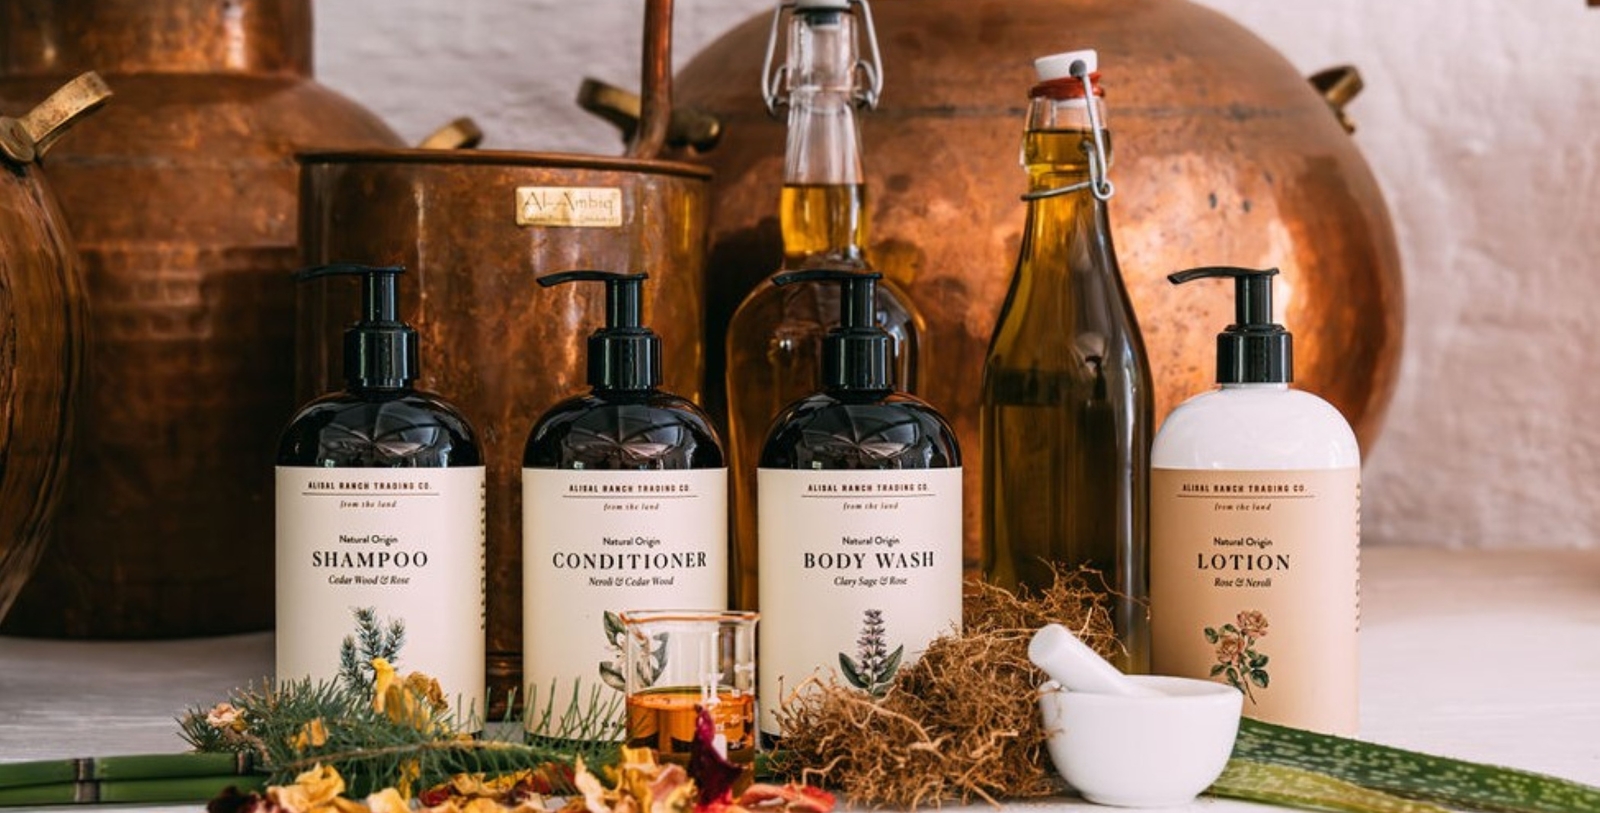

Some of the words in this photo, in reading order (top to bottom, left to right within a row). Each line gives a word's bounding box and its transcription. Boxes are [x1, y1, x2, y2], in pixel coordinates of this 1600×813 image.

[339, 481, 369, 490] RANCH
[374, 481, 414, 490] TRADING
[418, 481, 432, 490] CO.
[602, 484, 633, 493] RANCH
[637, 484, 676, 492] TRADING
[841, 484, 872, 492] RANCH
[877, 483, 914, 492] TRADING
[1214, 484, 1244, 493] RANCH
[1249, 484, 1289, 493] TRADING
[1293, 484, 1307, 492] CO.
[340, 500, 358, 508] from
[362, 500, 375, 508] the
[377, 500, 398, 508] land
[603, 503, 622, 511] from
[843, 502, 862, 511] from
[864, 502, 878, 510] the
[880, 502, 899, 510] land
[1214, 503, 1233, 511] from
[1236, 503, 1249, 511] the
[1252, 503, 1271, 511] land
[339, 535, 369, 544] Natural
[371, 534, 398, 546] Origin
[602, 537, 633, 546] Natural
[635, 536, 660, 548] Origin
[841, 536, 872, 545] Natural
[874, 536, 900, 548] Origin
[1213, 537, 1244, 546] Natural
[1245, 537, 1273, 549] Origin
[312, 551, 428, 568] SHAMPOO
[552, 552, 707, 570] CONDITIONER
[803, 552, 866, 569] BODY
[876, 551, 934, 569] WASH
[1197, 553, 1290, 571] LOTION
[328, 575, 352, 585] Cedar
[354, 575, 378, 585] Wood
[379, 575, 389, 585] &
[390, 575, 410, 585] Rose
[589, 577, 613, 586] Neroli
[614, 577, 623, 586] &
[624, 576, 650, 586] Cedar
[652, 576, 674, 586] Wood
[833, 576, 856, 588] Clary
[858, 576, 877, 588] Sage
[879, 576, 888, 585] &
[889, 576, 908, 585] Rose
[1214, 577, 1233, 587] Rose
[1234, 577, 1244, 587] &
[1245, 577, 1271, 587] Neroli
